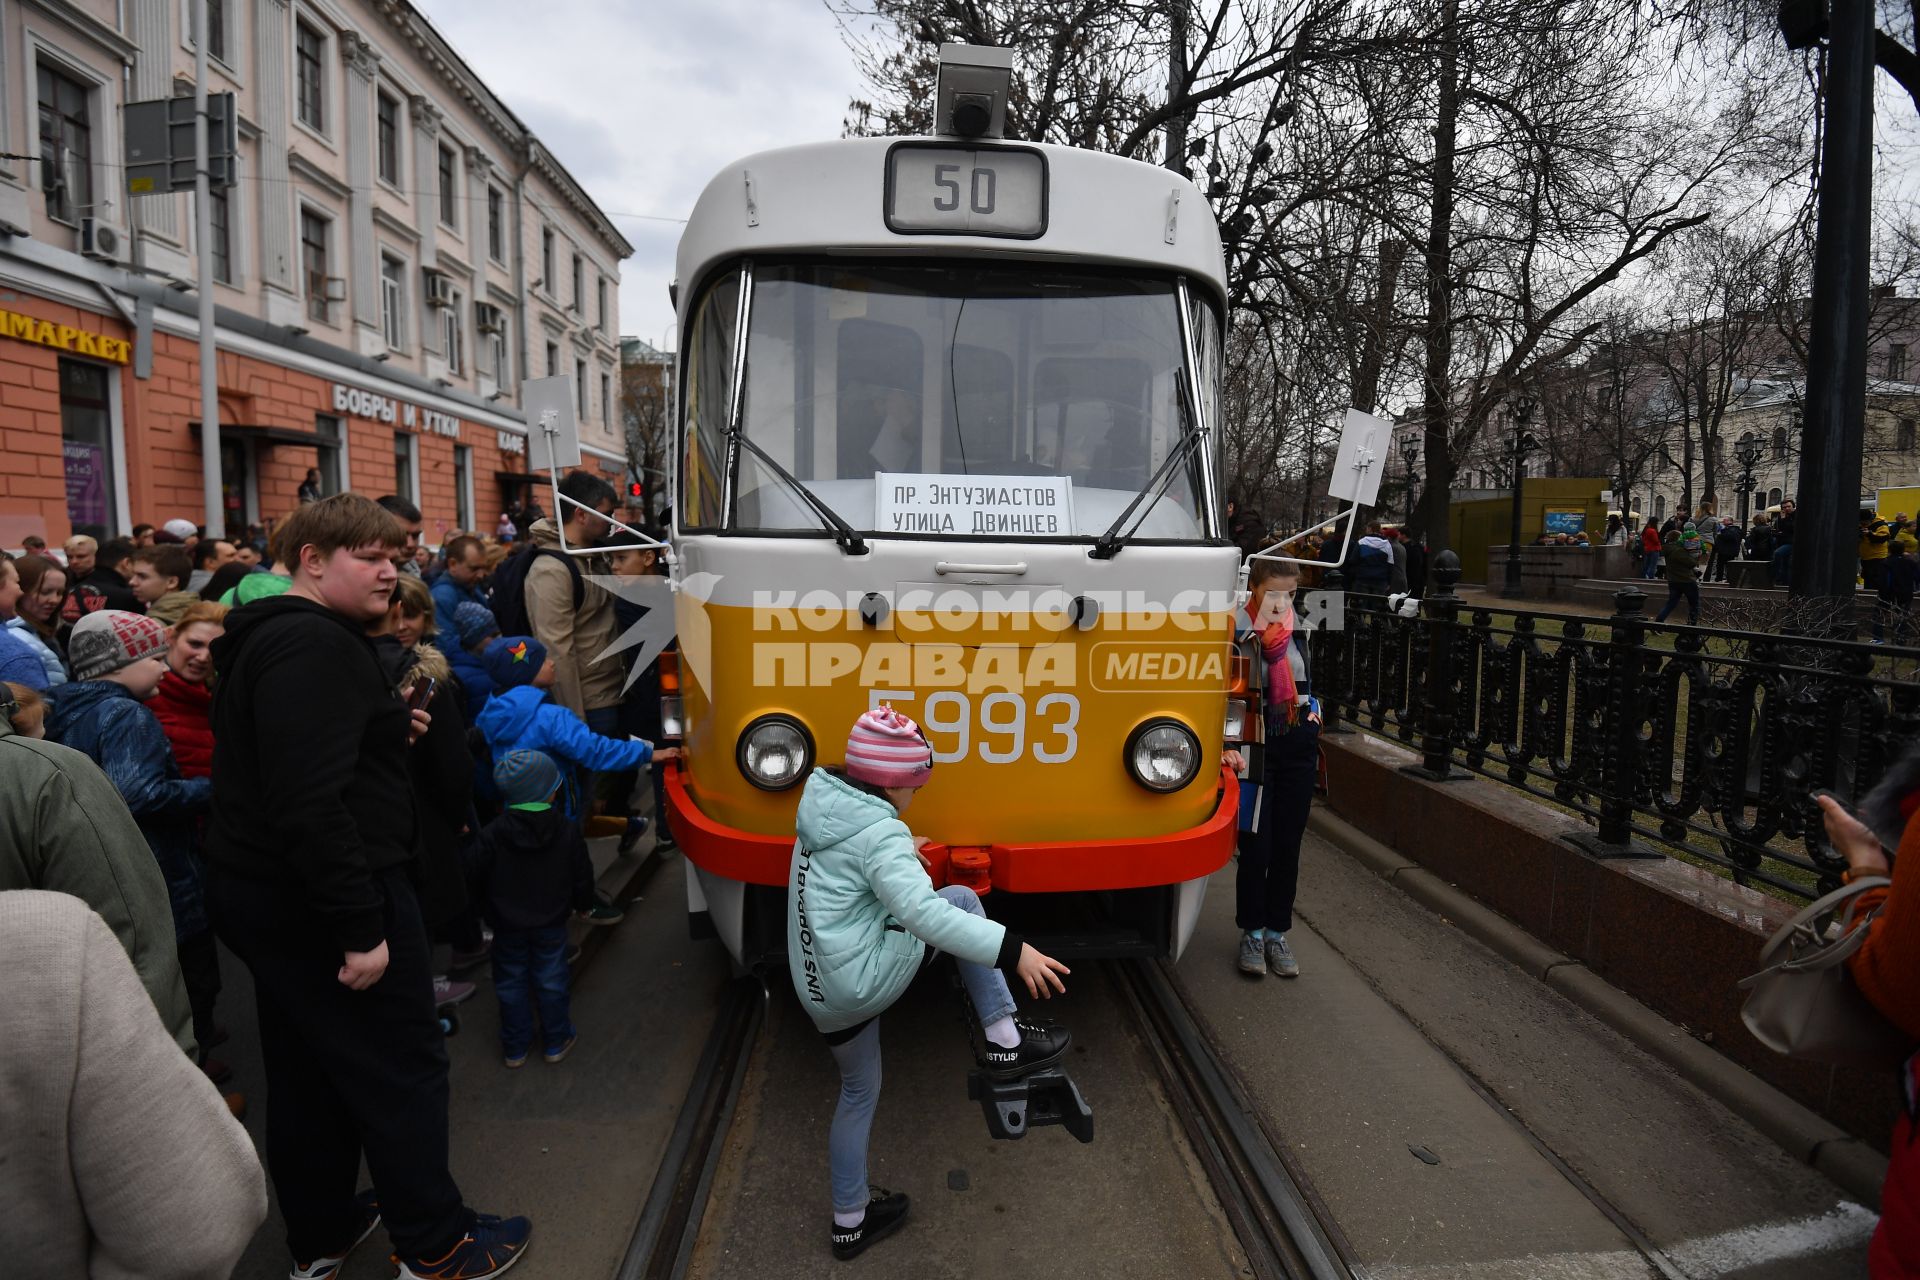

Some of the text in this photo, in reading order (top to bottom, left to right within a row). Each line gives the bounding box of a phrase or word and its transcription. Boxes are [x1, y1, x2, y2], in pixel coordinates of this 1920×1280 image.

[934, 165, 996, 214] 50
[333, 384, 460, 438] БОБРЫ И УТКИ
[894, 484, 1056, 506] ПР. ЭНТУЗИАСТОВ
[893, 511, 1058, 534] УЛИЦА ДВИНЦЕВ
[798, 846, 825, 1002] UNSTOPPABLE
